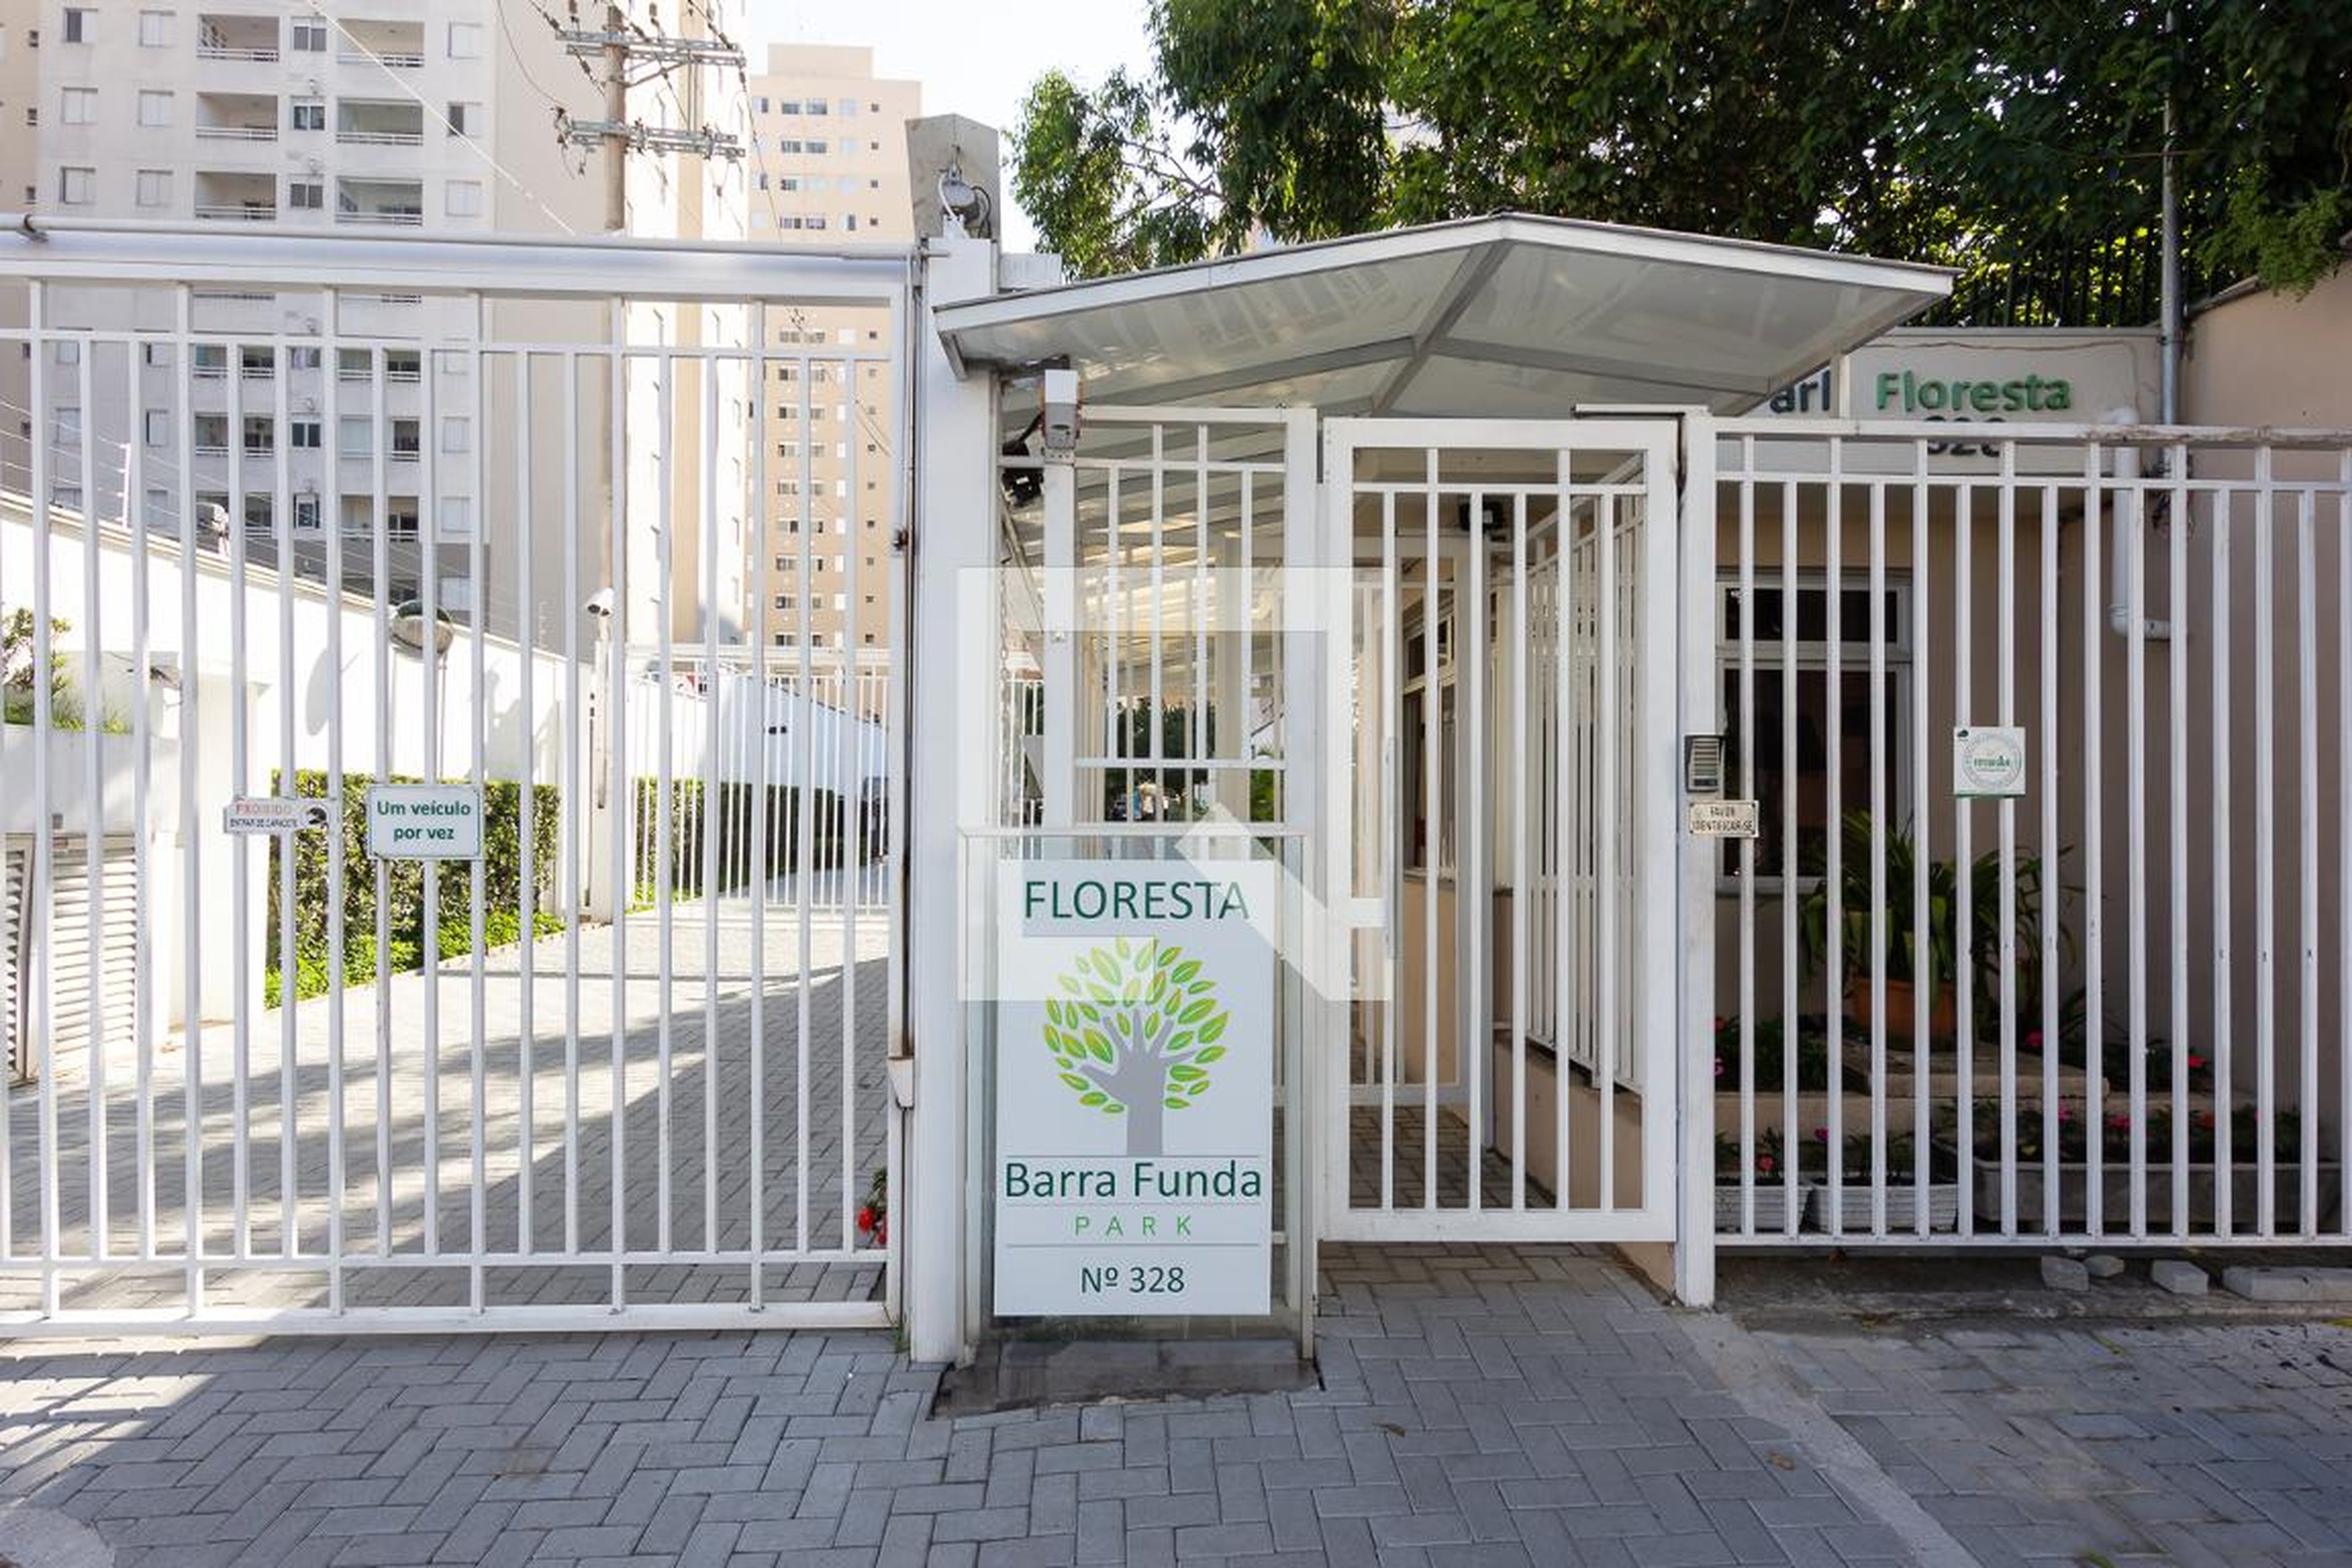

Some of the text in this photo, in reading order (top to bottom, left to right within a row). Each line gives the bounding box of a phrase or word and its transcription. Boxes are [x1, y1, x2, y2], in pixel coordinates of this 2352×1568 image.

[1876, 370, 2071, 412] Floresta
[377, 801, 405, 815] Um
[394, 828, 454, 842] por vez
[1025, 881, 1250, 919] FLORESTA
[1006, 1159, 1261, 1197] Barra Funda
[1074, 1216, 1192, 1236] PARK
[1129, 1267, 1185, 1294] 328
